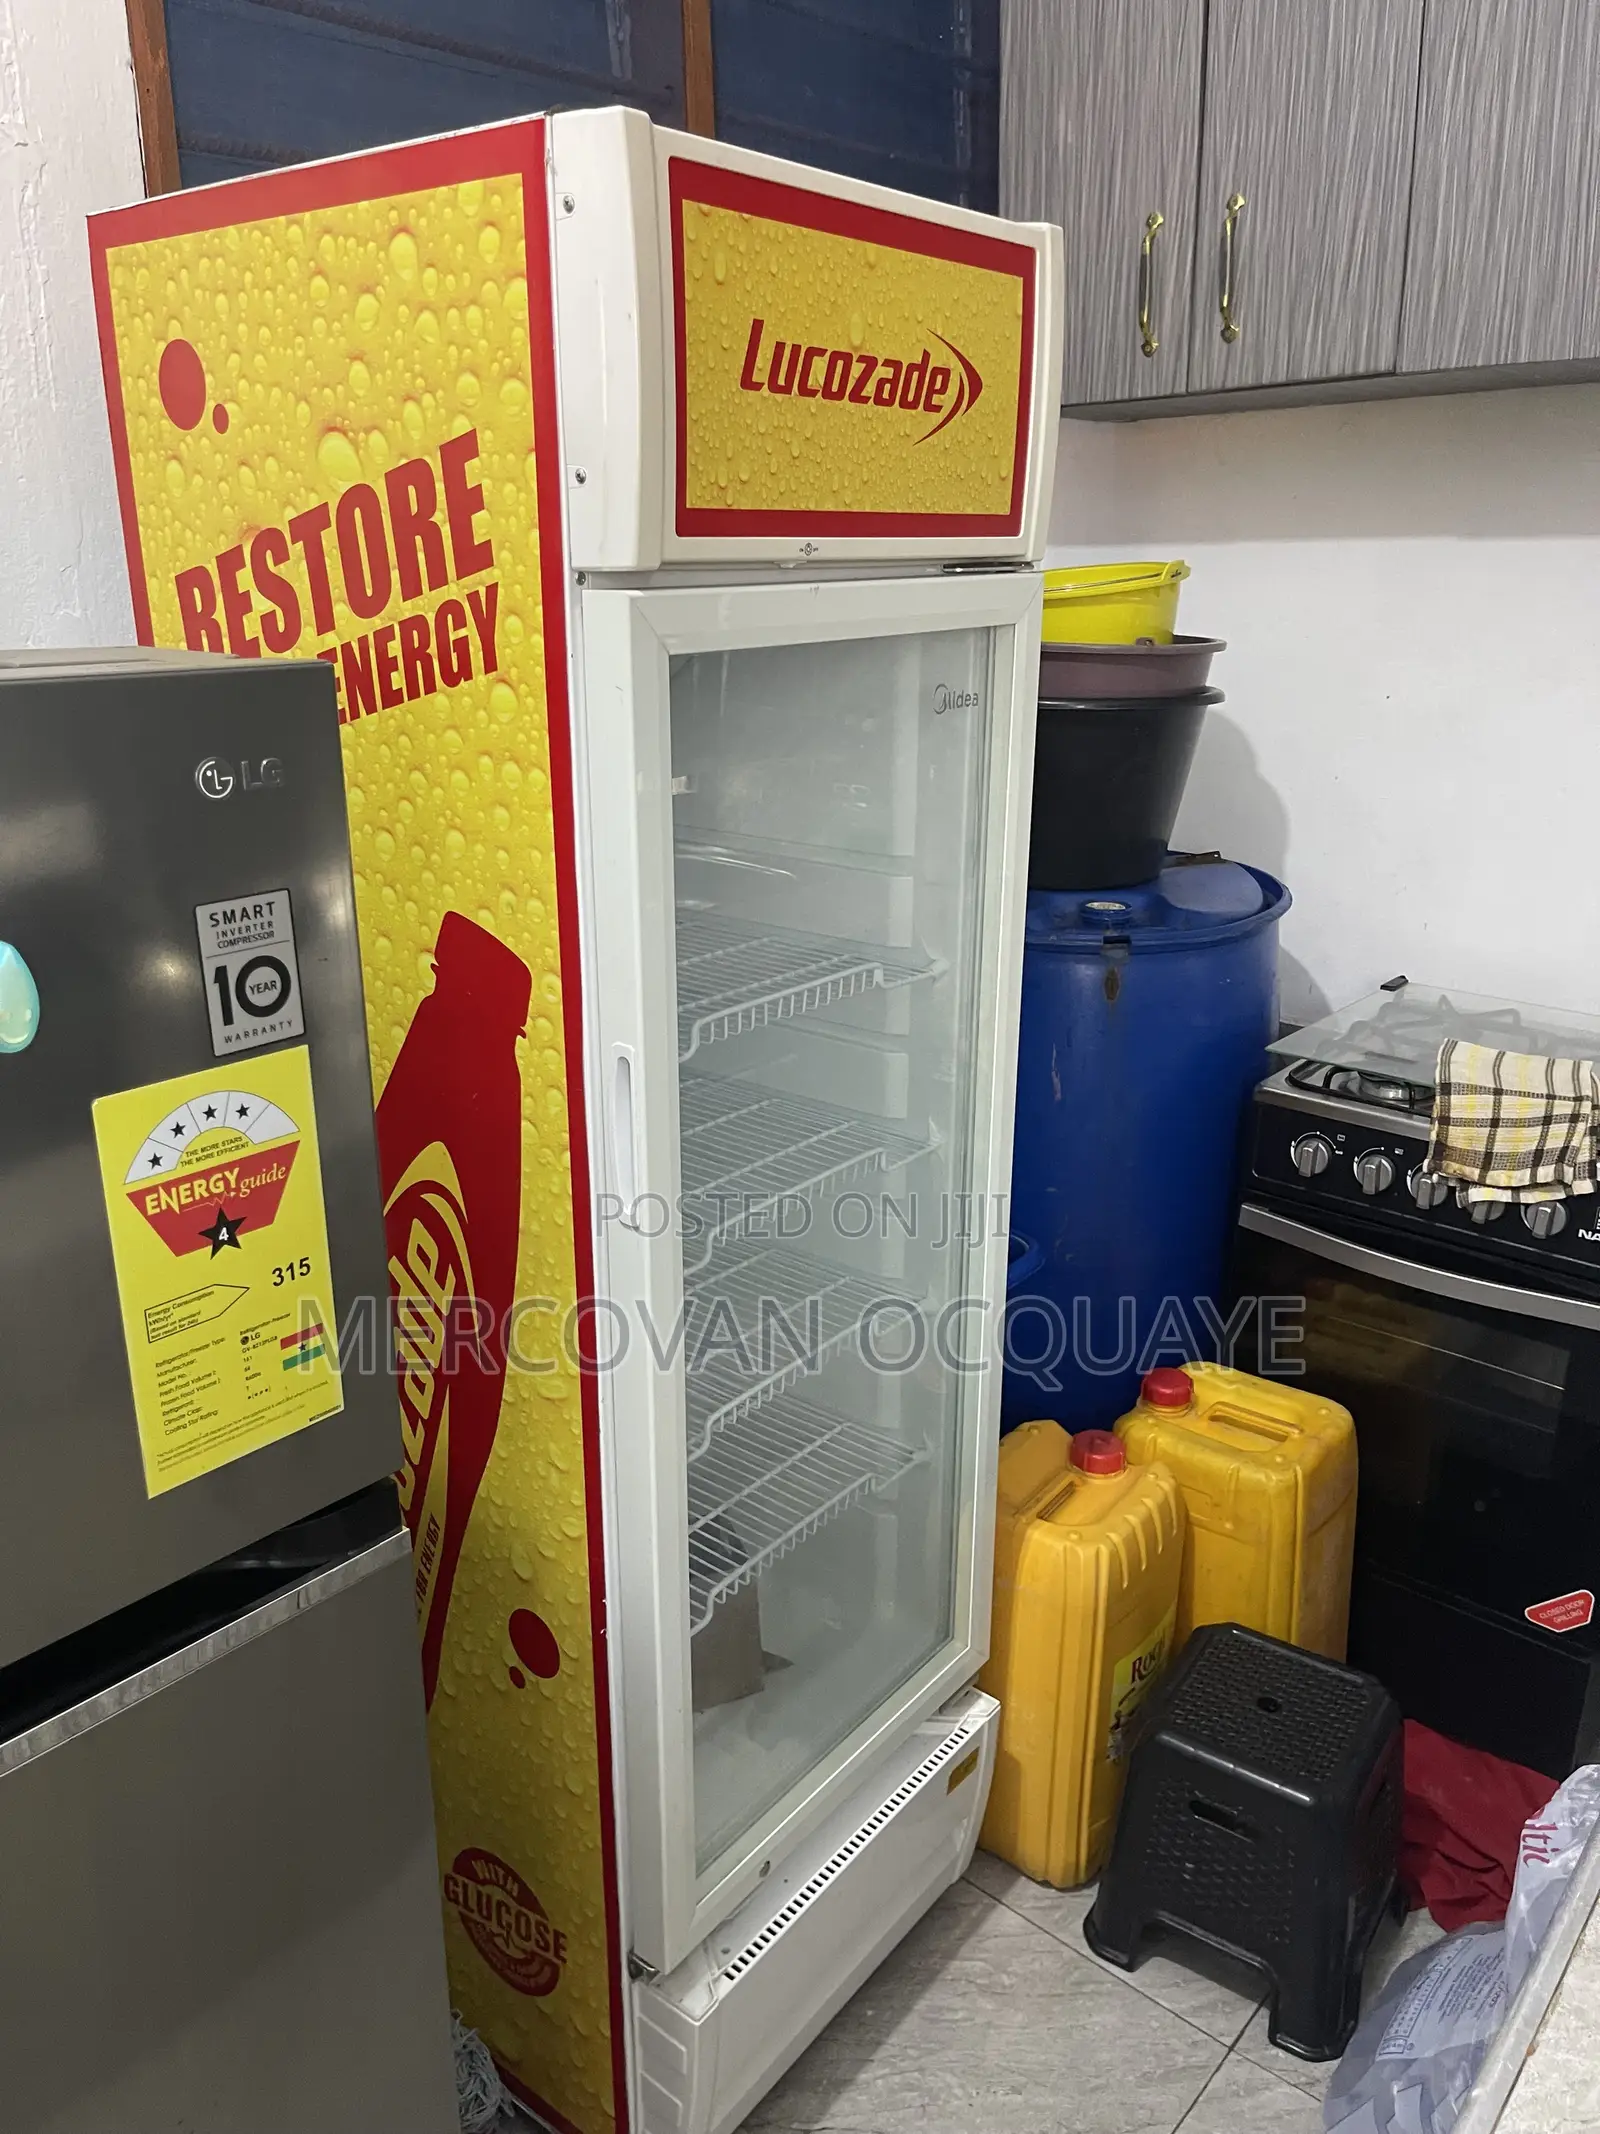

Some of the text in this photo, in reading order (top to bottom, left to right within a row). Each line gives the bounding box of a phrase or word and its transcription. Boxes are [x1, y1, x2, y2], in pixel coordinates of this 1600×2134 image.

[739, 318, 952, 414] Lucozade
[175, 428, 495, 659] RESTORE
[241, 757, 284, 791] LG
[209, 901, 275, 928] SMART
[216, 920, 274, 940] INVERTER
[217, 930, 275, 949] COMPRESSOR
[213, 955, 291, 1027] 10
[249, 980, 278, 996] YEAR
[224, 1019, 293, 1044] WARRANTY
[180, 1158, 195, 1168] THE
[195, 1151, 216, 1163] MORE
[185, 1135, 243, 1158] THE MORE STARS
[144, 1162, 287, 1216] ENERGY guide
[218, 1226, 229, 1241] 4
[271, 1256, 312, 1287] 315
[471, 1859, 520, 1898] WITH
[443, 1872, 568, 1964] GLUCOSE
